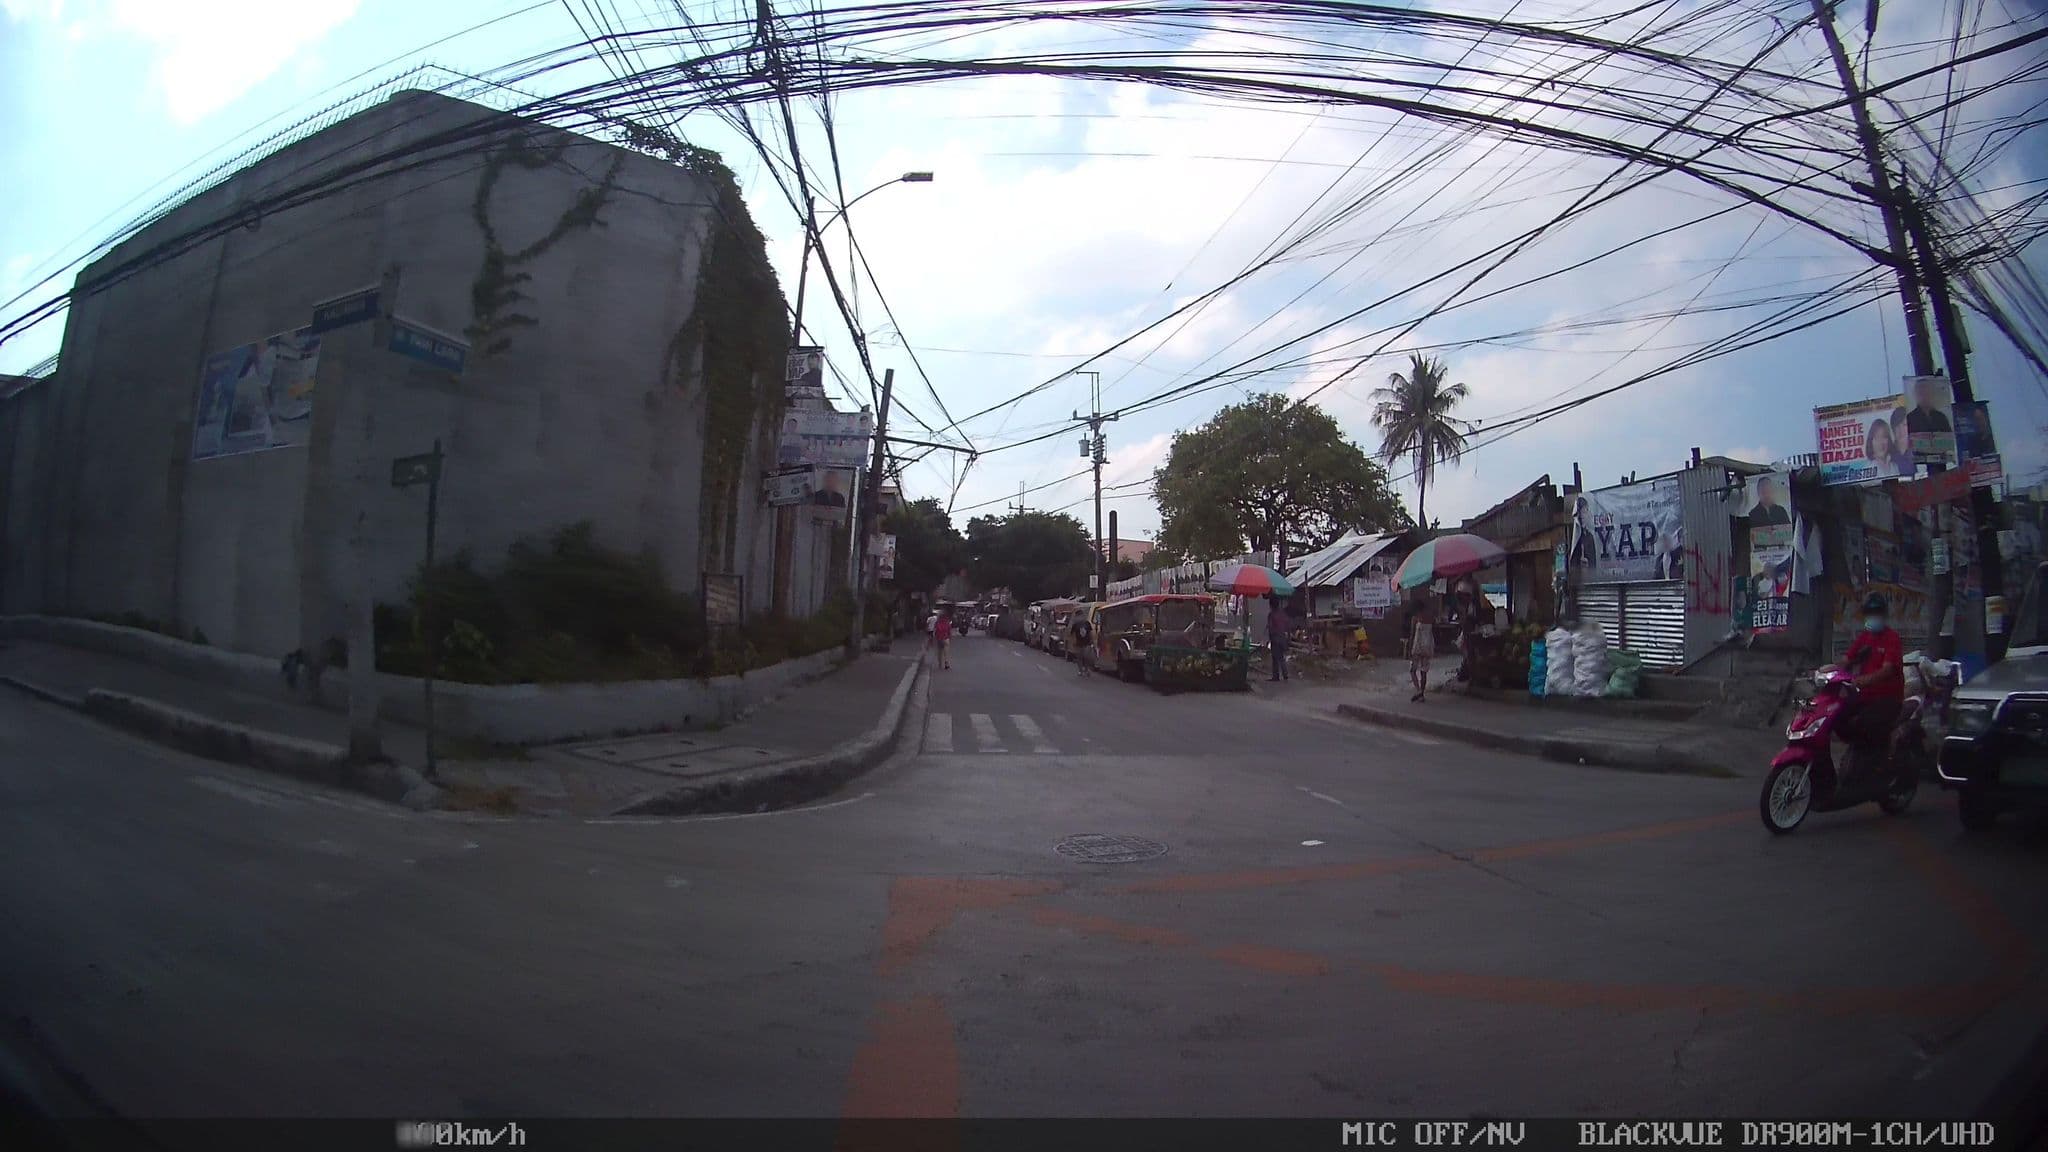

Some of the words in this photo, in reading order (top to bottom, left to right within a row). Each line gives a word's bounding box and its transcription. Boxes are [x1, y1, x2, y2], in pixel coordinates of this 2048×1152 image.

[1819, 423, 1863, 439] NANETTE
[1820, 435, 1864, 451] CASTELO
[1822, 448, 1865, 464] DAZA
[1594, 521, 1658, 559] YAP
[1753, 614, 1787, 627] ELEAZAR
